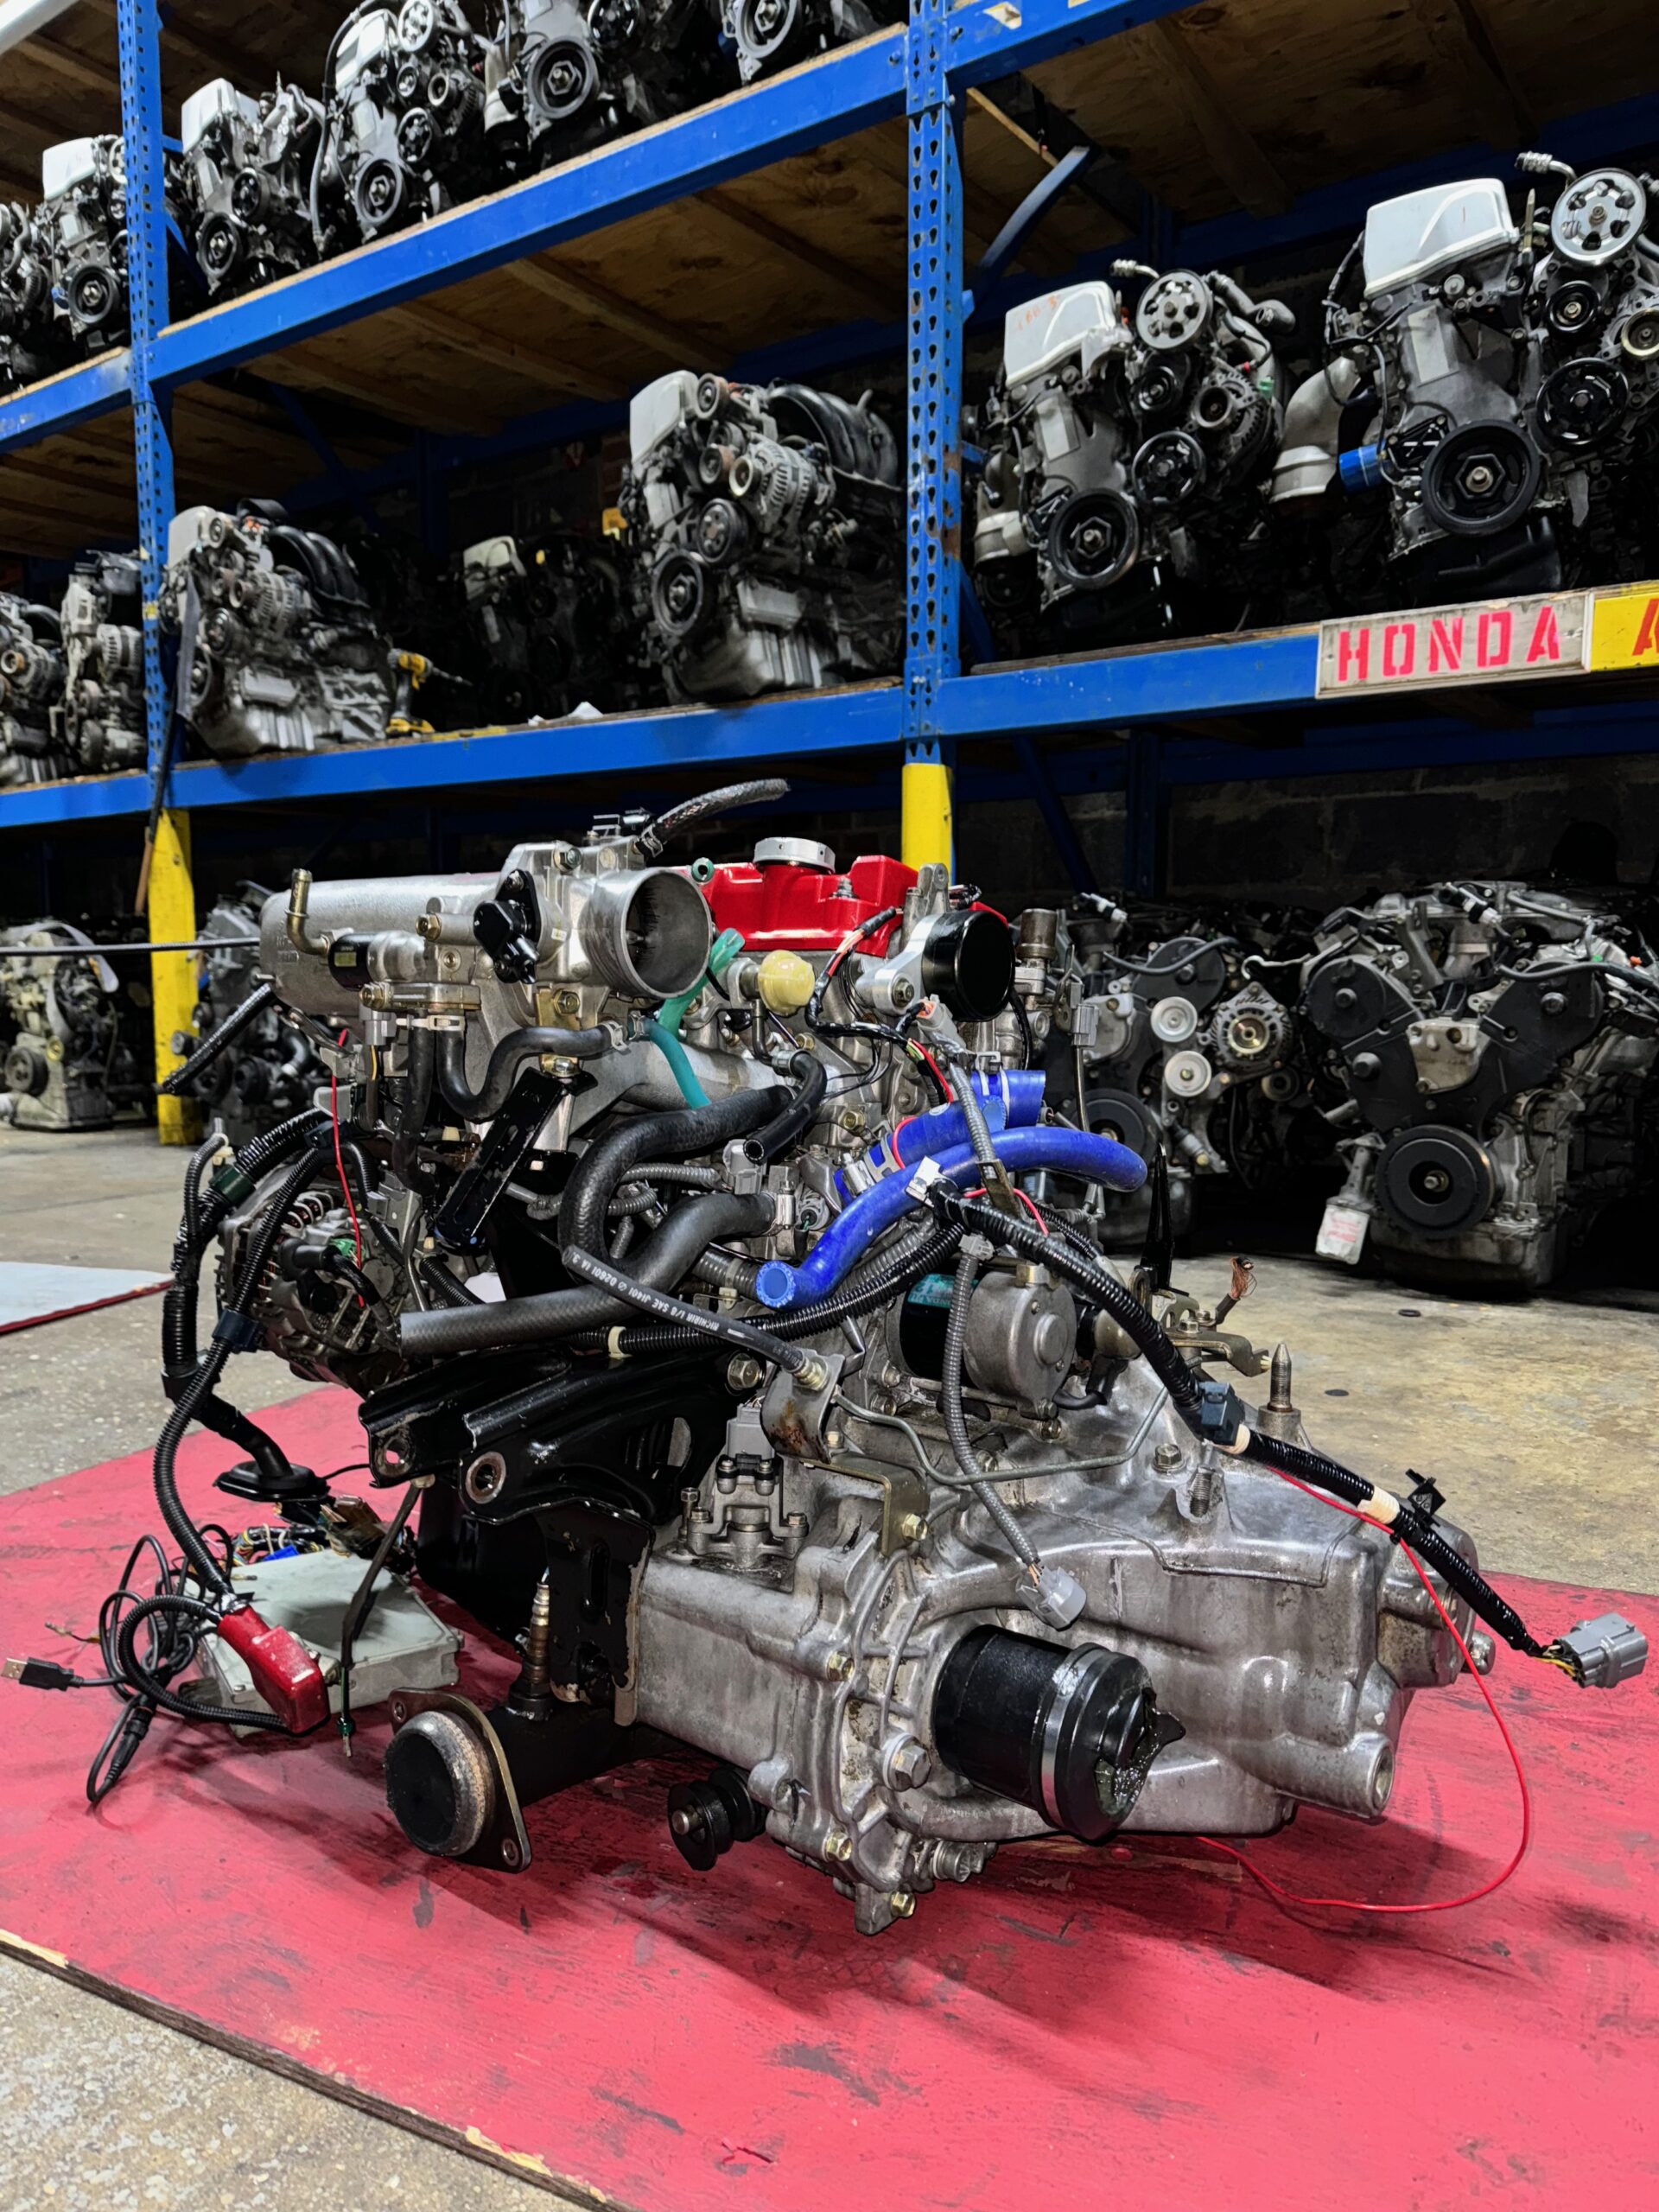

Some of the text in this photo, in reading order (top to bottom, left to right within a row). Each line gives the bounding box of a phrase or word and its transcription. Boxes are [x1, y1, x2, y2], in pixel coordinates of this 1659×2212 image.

[1338, 606, 1560, 682] HONDA
[628, 1287, 652, 1303] J1401
[652, 1298, 670, 1313] SAE
